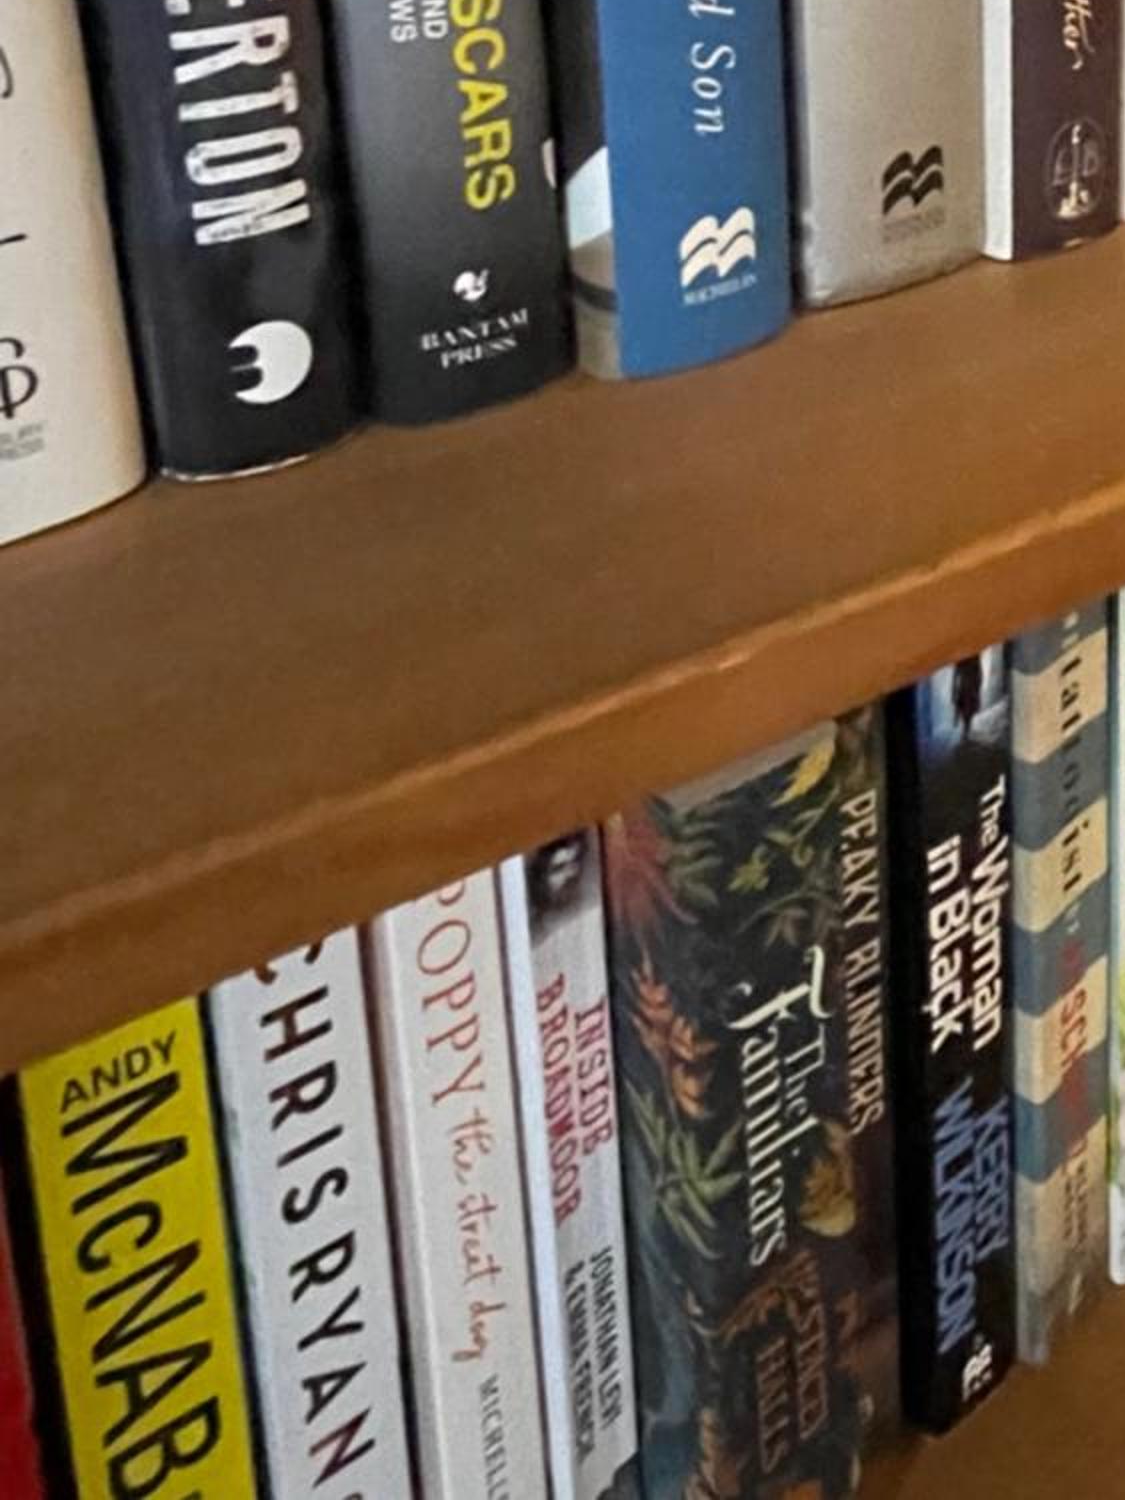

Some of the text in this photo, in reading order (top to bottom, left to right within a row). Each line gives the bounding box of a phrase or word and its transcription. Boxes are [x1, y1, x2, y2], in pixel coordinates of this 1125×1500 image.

[685, 42, 736, 137] Son
[419, 309, 528, 350] BANTAM
[440, 330, 516, 368] PRESS
[839, 787, 886, 1137] PEAKY BLINDERS
[922, 834, 970, 1053] in Black
[969, 774, 1013, 1051] The Woman
[58, 1031, 179, 1113] ANDY
[451, 1108, 496, 1185] the
[535, 972, 582, 1229] BROADMOOR
[573, 994, 613, 1160] INSIDE
[728, 944, 833, 1268] Familiars
[456, 1190, 505, 1289] street
[931, 1076, 977, 1355] WILKINSON
[974, 1103, 1010, 1262] KERRY
[59, 1071, 223, 1500] McNAB
[288, 1230, 377, 1490] RYAN
[452, 1300, 506, 1362] dog
[478, 1374, 512, 1500] MICHELL
